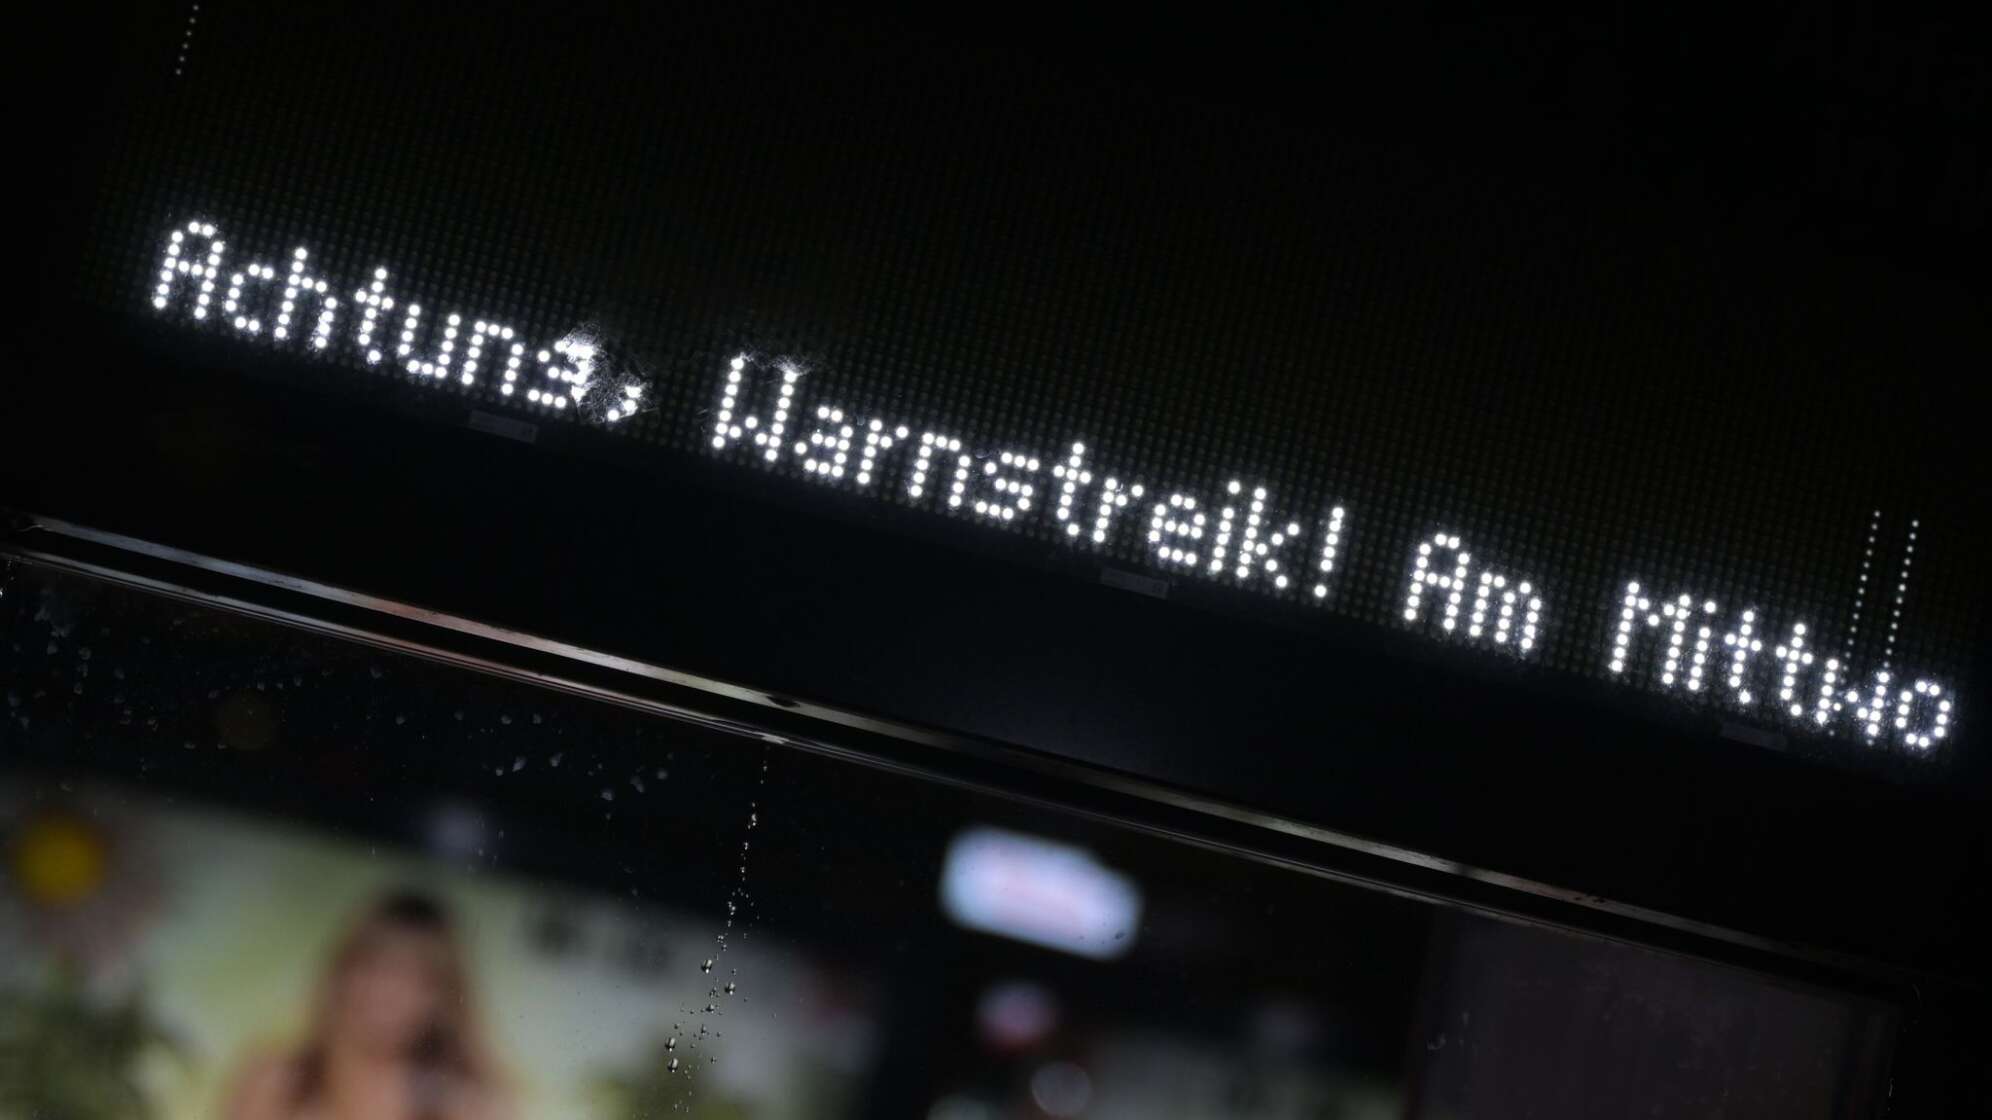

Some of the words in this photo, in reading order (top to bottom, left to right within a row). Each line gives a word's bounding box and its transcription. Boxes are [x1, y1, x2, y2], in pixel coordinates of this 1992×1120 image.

[711, 353, 1345, 598] Warnstreik!
[1403, 533, 1542, 653] Am
[1609, 581, 1951, 748] Mittwo
